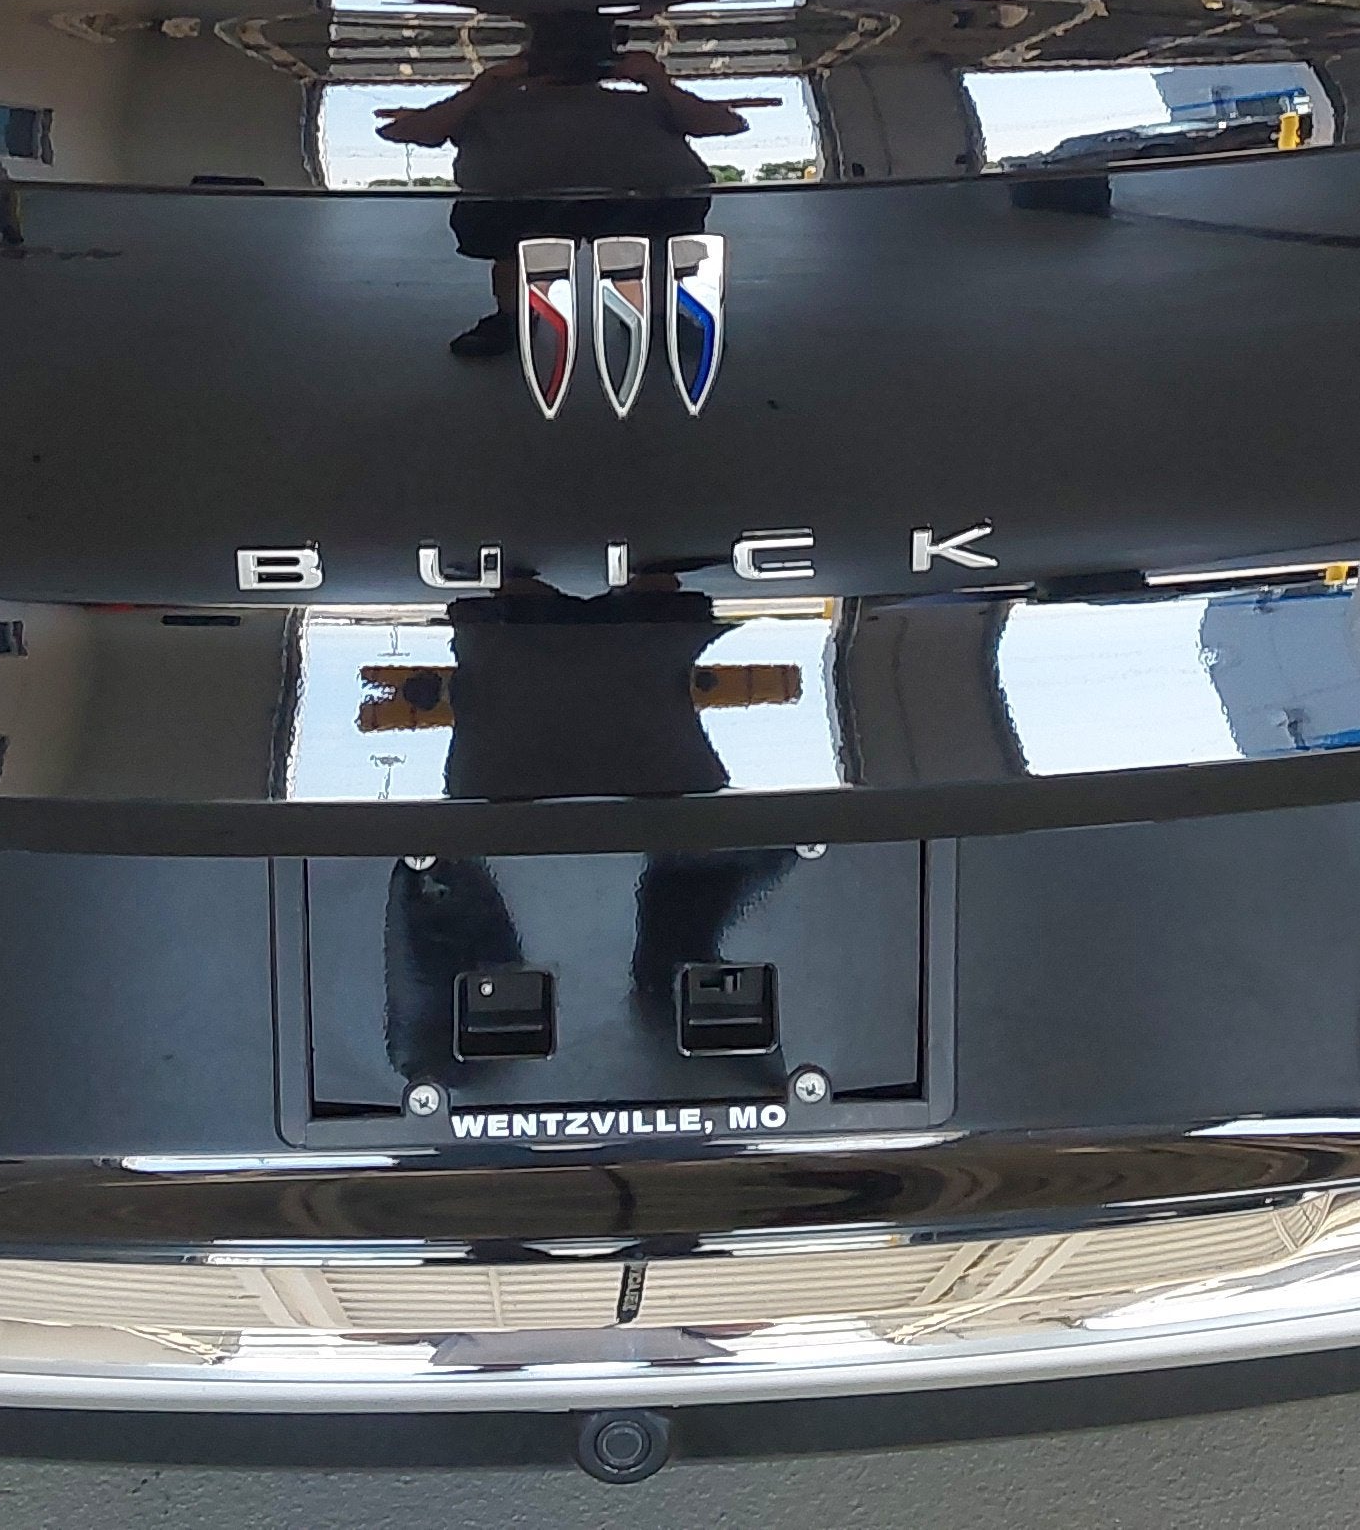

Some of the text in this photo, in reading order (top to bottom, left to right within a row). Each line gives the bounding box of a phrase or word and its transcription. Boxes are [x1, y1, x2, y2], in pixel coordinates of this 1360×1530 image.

[234, 518, 1002, 592] BUICK
[451, 1104, 787, 1138] WENTZVILLE, MO
